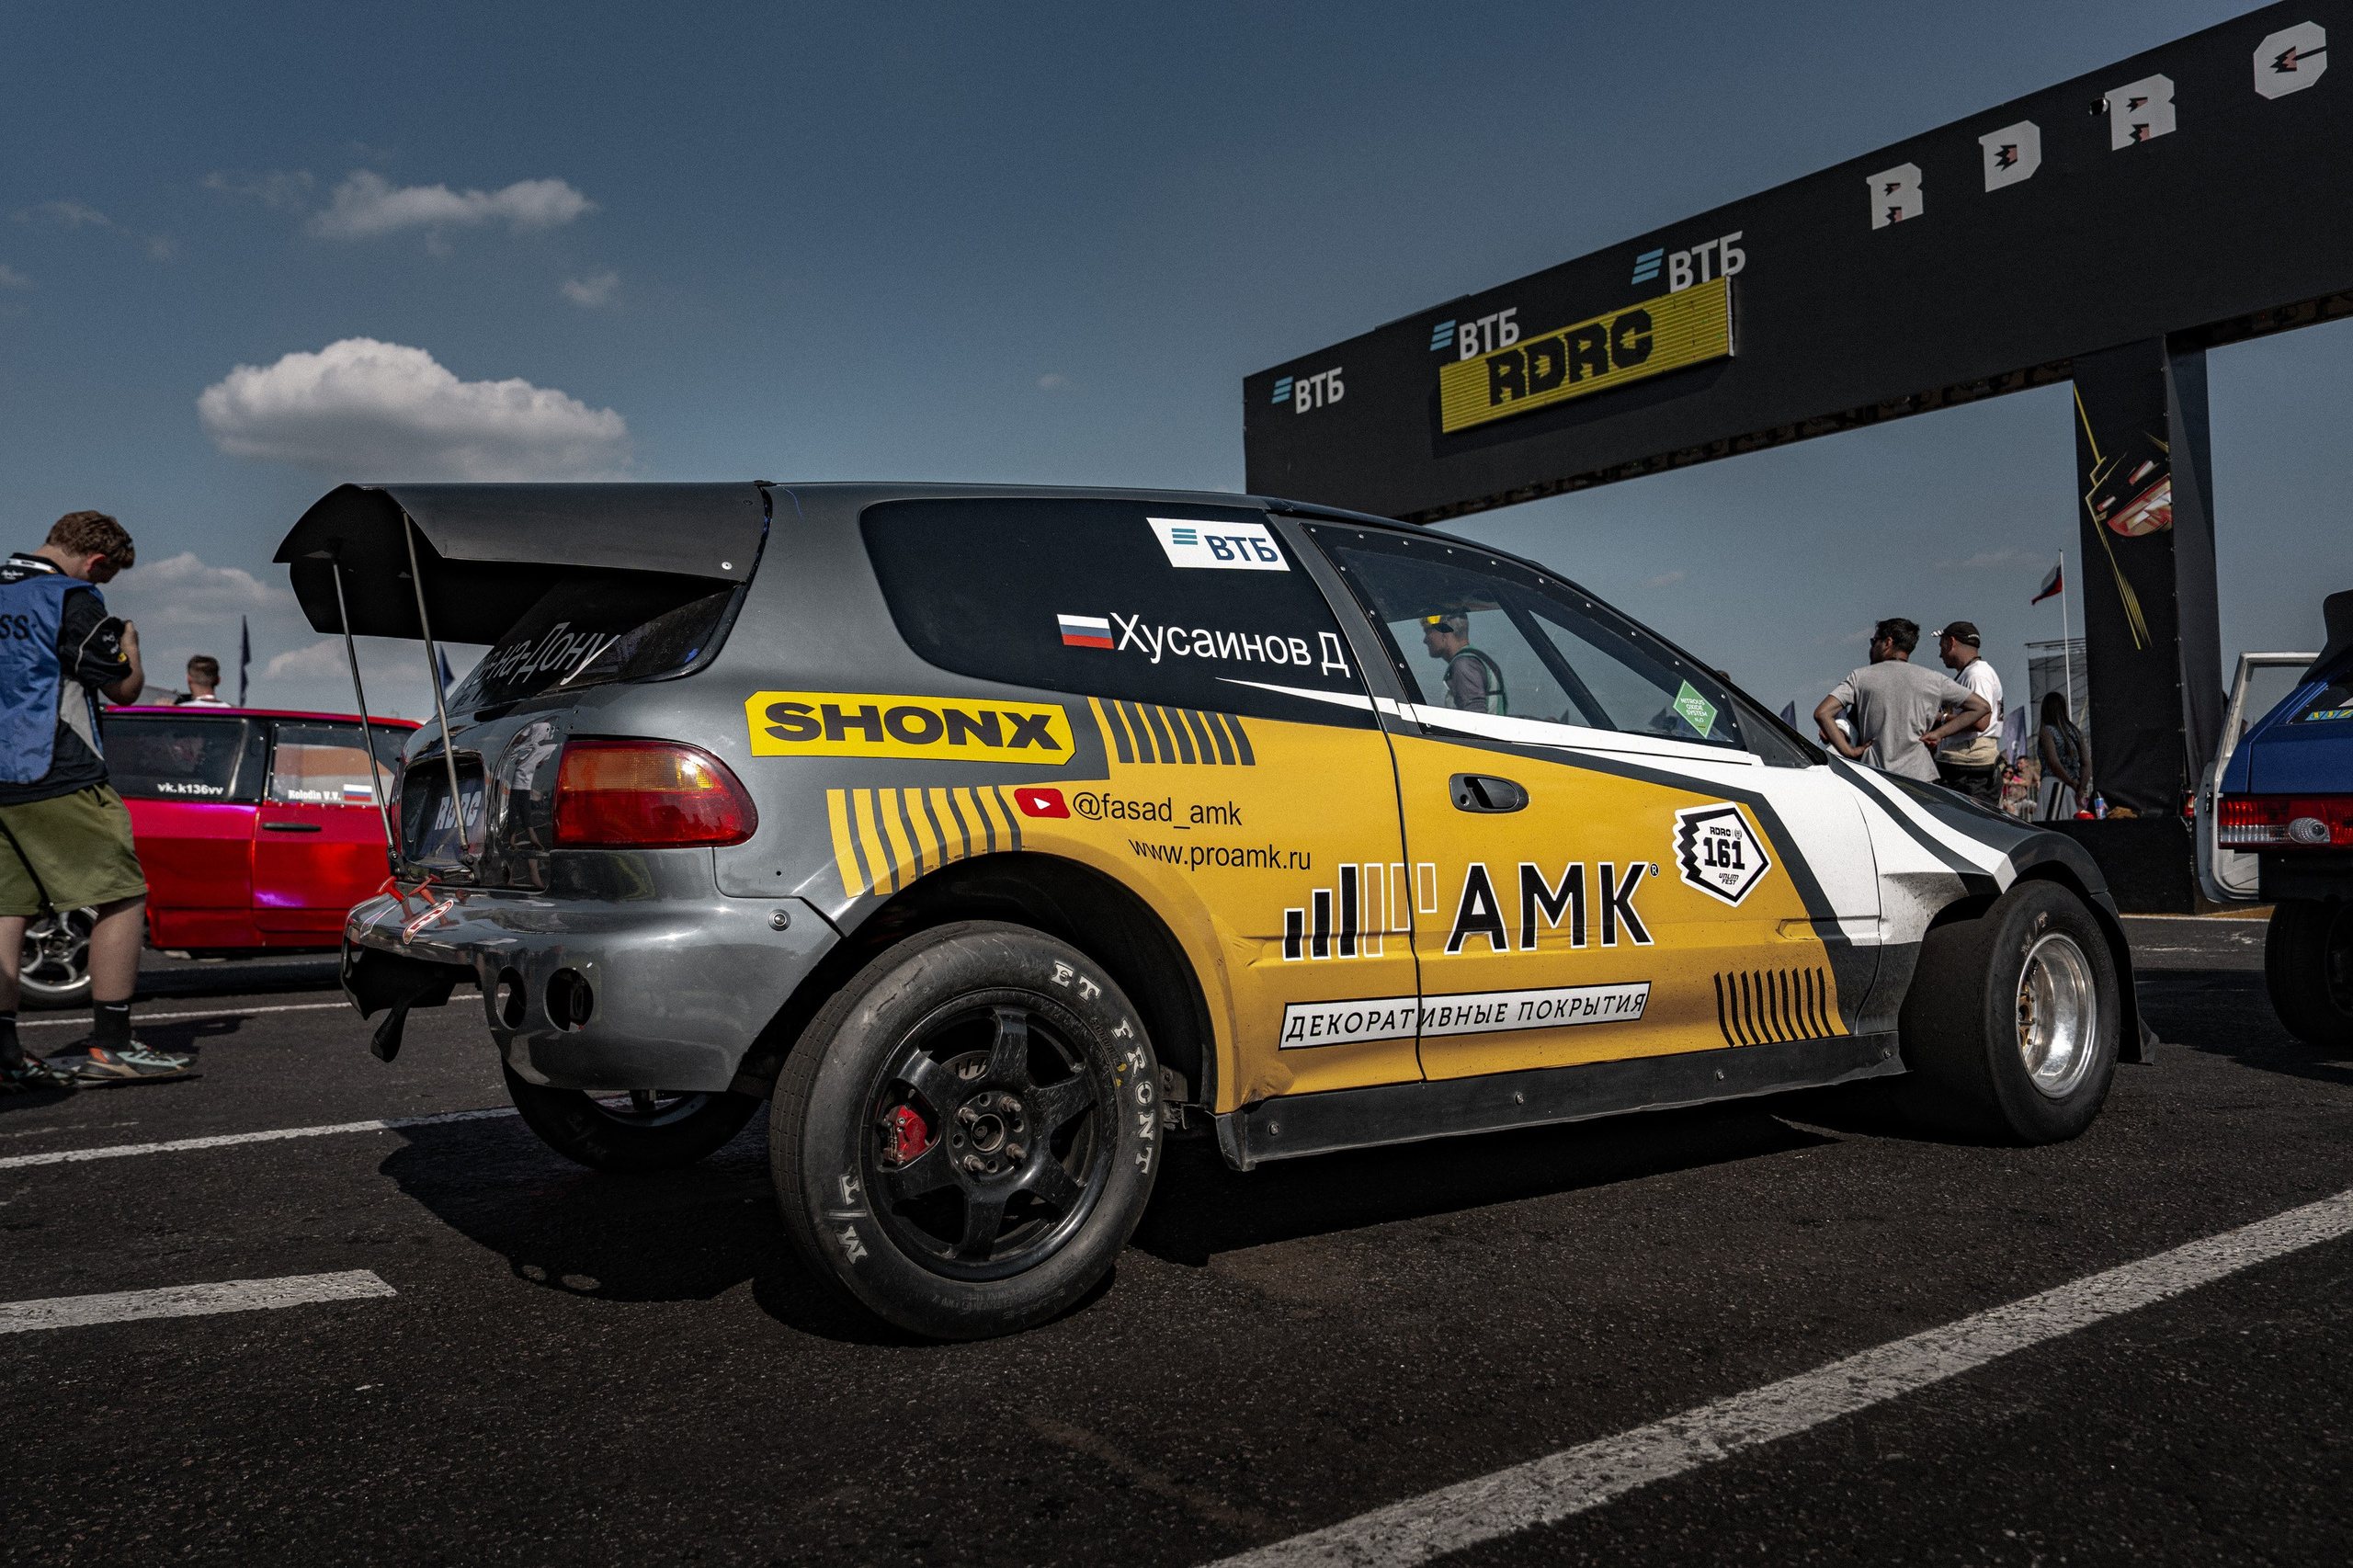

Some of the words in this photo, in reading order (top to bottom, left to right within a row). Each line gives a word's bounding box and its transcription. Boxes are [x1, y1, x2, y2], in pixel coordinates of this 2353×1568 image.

[1866, 20, 2328, 231] RDRC
[1668, 231, 1746, 293] ВТБ
[1458, 307, 1520, 360] ВТБ
[1484, 308, 1654, 407] RDRC
[1294, 368, 1345, 415] ВТБ
[1203, 535, 1279, 562] ВТБ
[1109, 612, 1313, 666] Хусаинов
[1317, 631, 1351, 678] Д
[764, 701, 1063, 751] SHONX
[288, 789, 322, 801] Kolodin
[1073, 791, 1243, 830] @fasad_amk
[1128, 838, 1312, 871] www.proamk.ru
[1703, 836, 1745, 870] 161
[1710, 825, 1732, 837] RDRC
[1285, 1002, 1507, 1042] ДЕКОРАТИВНЫЕ
[1518, 993, 1646, 1022] ПОКРЫТИЯ
[1051, 960, 1101, 1002] ET
[1111, 1017, 1154, 1175] FRONT
